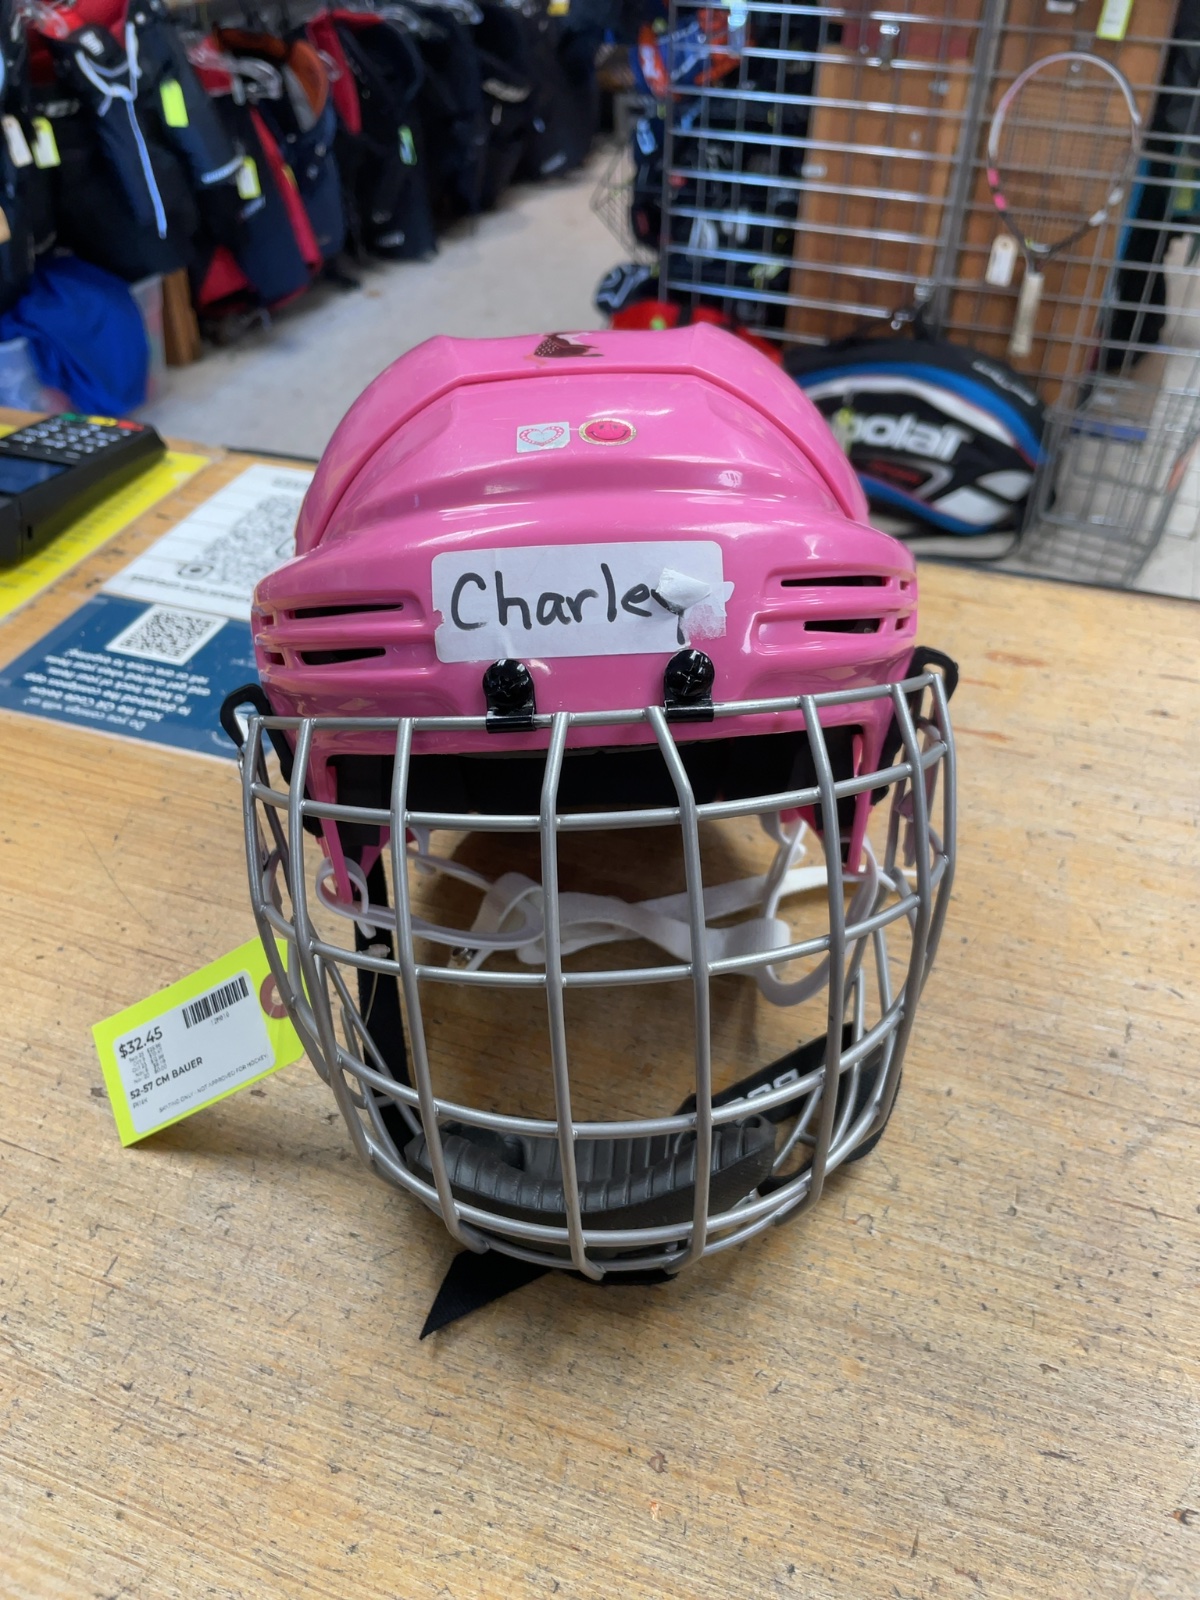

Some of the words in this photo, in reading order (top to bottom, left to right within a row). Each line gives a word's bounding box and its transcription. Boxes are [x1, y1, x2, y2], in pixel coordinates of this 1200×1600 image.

[119, 1026, 163, 1059] $32.45
[130, 1081, 153, 1100] 52-57
[155, 1073, 171, 1087] CM
[171, 1056, 203, 1079] BAUER
[197, 1084, 208, 1093] NOT
[235, 1064, 247, 1074] FOR
